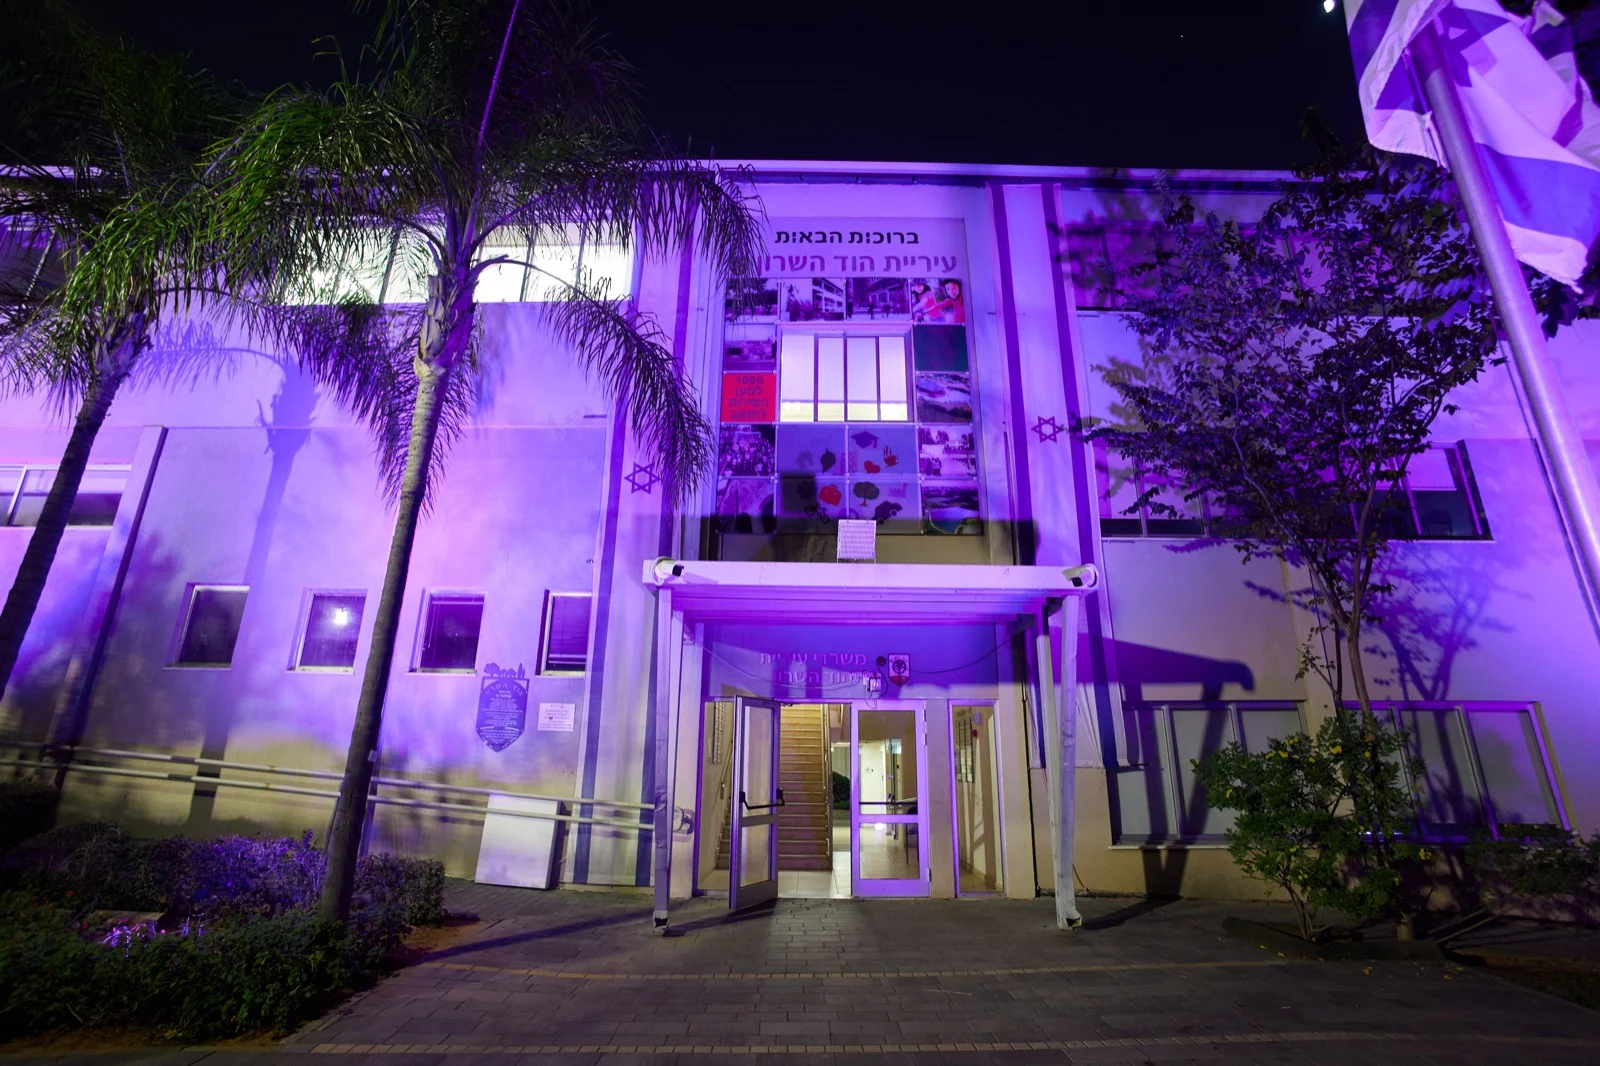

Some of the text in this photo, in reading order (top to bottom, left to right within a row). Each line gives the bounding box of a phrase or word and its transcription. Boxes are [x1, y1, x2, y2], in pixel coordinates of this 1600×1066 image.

[757, 255, 957, 276] עיריית הוד השרון
[735, 386, 763, 398] למען
[813, 653, 867, 666] משרדי
[824, 672, 849, 684] הוד
